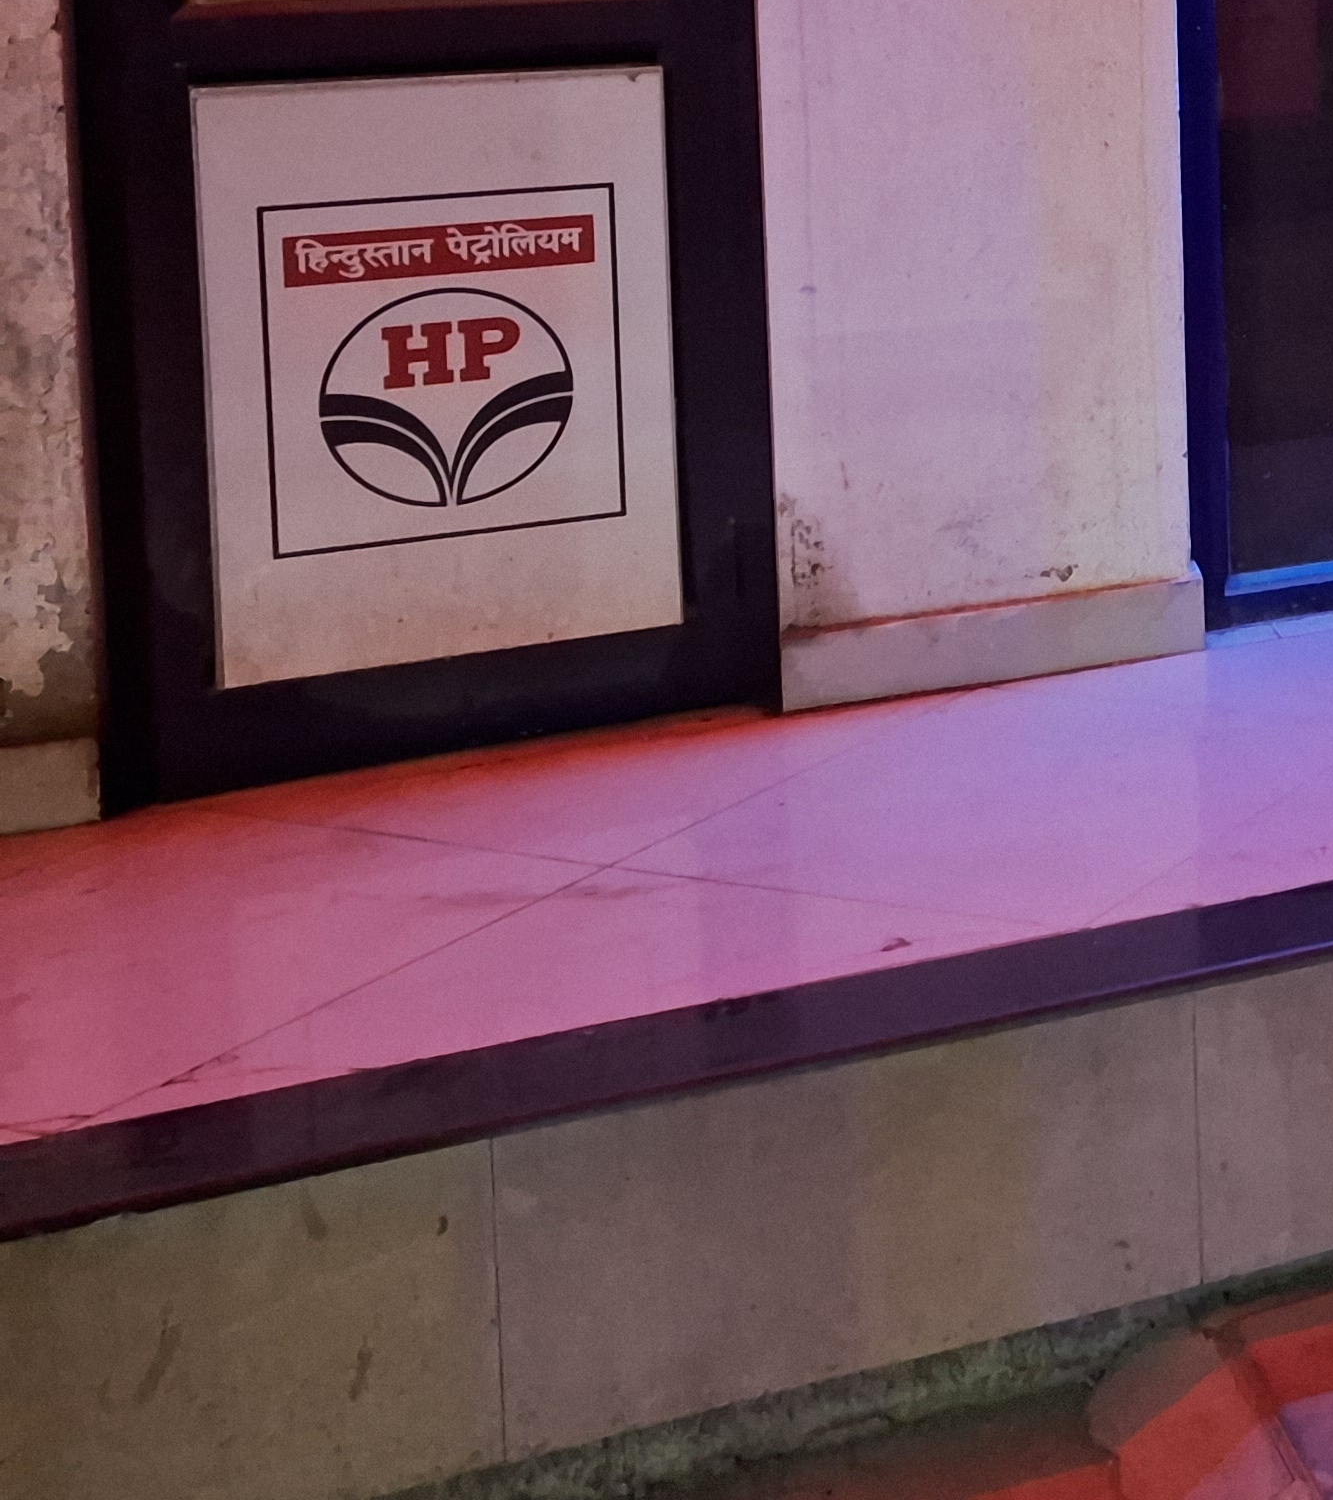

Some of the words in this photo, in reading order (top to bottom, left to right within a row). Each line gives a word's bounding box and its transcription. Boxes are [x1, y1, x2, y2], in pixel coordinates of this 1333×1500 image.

[295, 238, 434, 278] हिन्दुस्तान
[446, 223, 583, 264] पेट्रोलियम
[381, 316, 521, 390] HP
